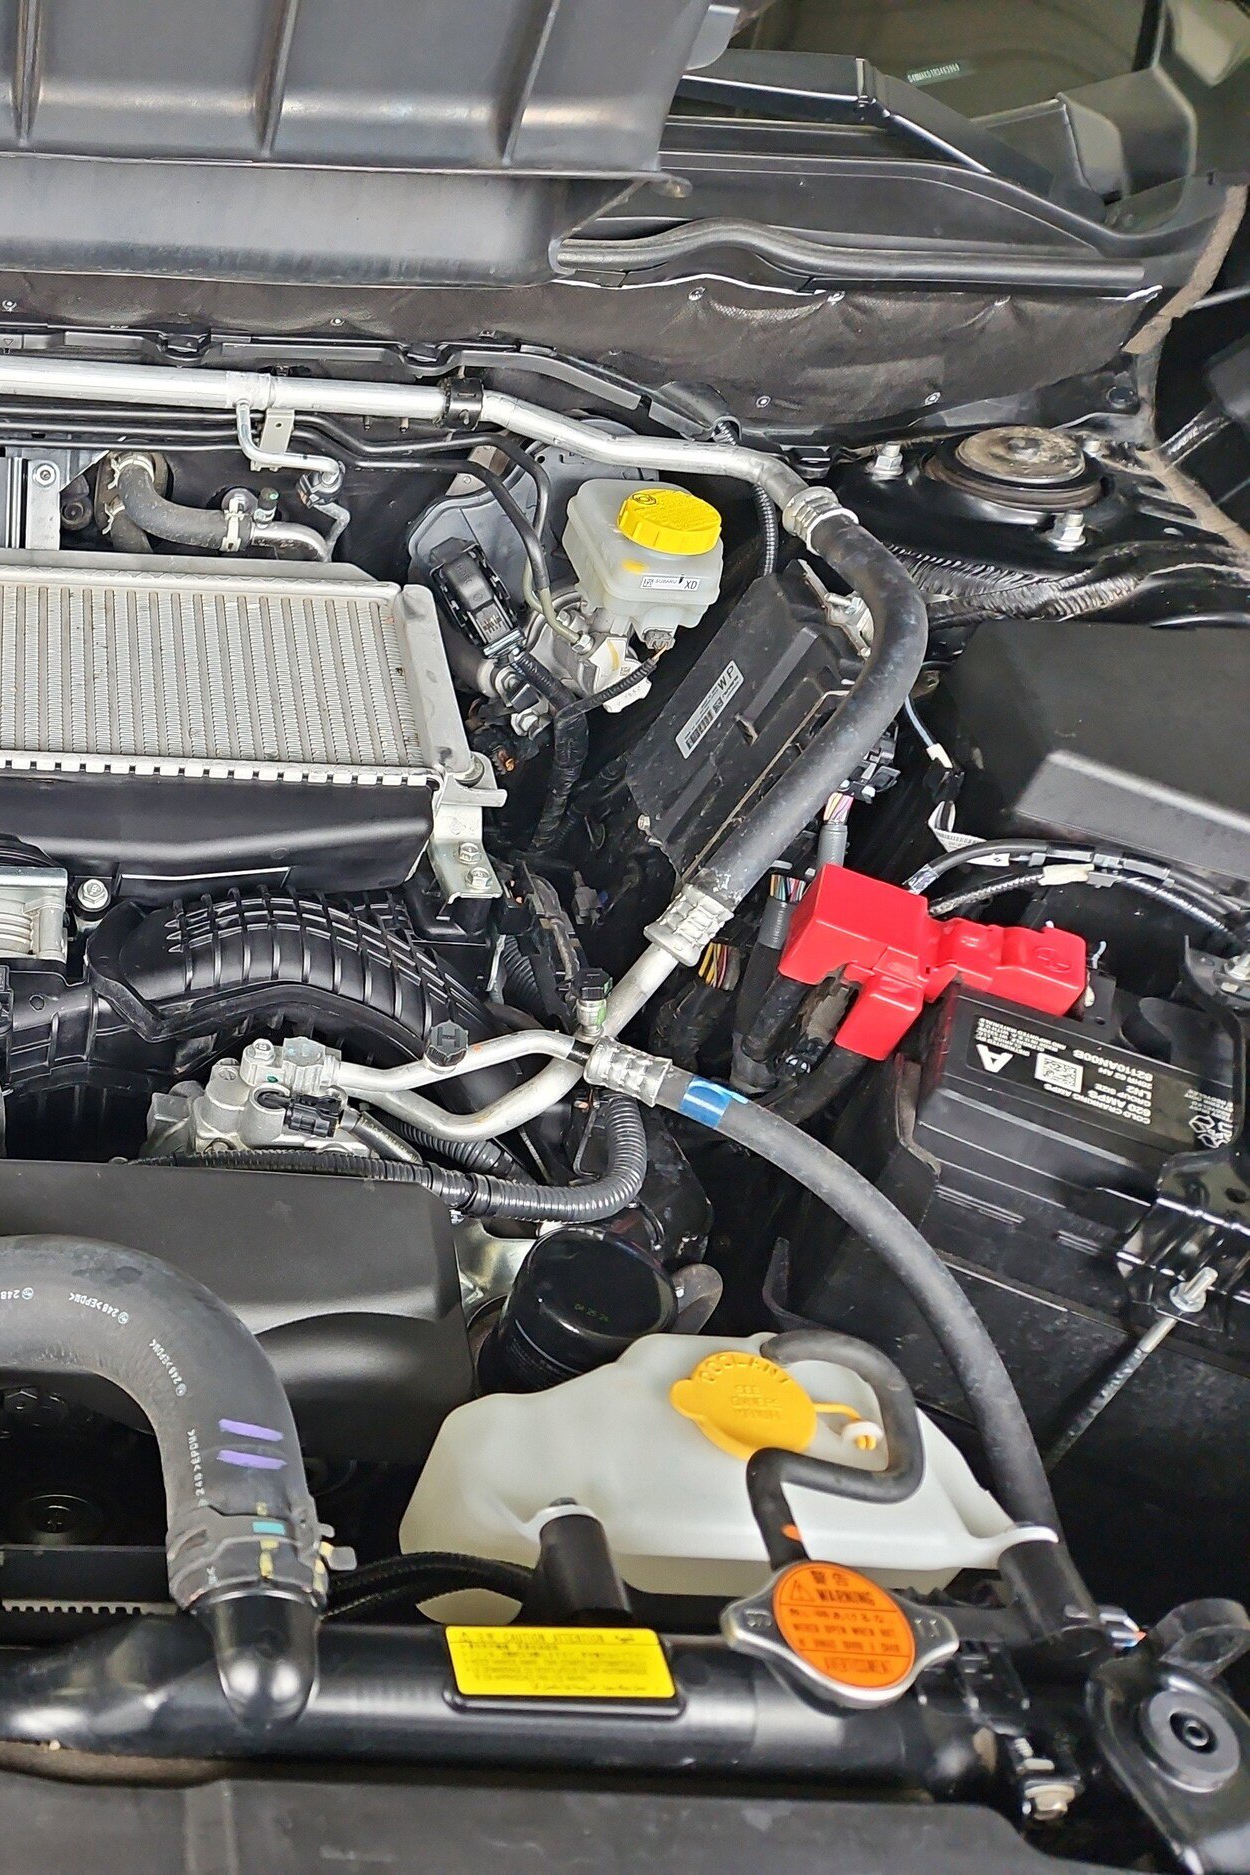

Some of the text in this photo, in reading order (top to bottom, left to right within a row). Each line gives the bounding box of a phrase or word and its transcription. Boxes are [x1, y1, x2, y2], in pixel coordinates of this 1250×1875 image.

[684, 580, 698, 590] XD
[437, 1027, 460, 1048] H
[978, 1017, 1066, 1051] AND IMPORTED MATERIALS
[986, 1037, 1029, 1057] DISTRIBUTED
[1071, 1047, 1153, 1082] 82110AN00B
[1097, 1066, 1152, 1089] 20HR 62 AH
[1093, 1082, 1151, 1107] GROUP SIZE
[1124, 1083, 1152, 1099] LN2
[1043, 1082, 1150, 1125] COLD CRANKING AMPS
[1086, 1088, 1151, 1117] 620 AMPS
[816, 1588, 875, 1606] WARNING
[503, 1632, 545, 1642] CAUTION
